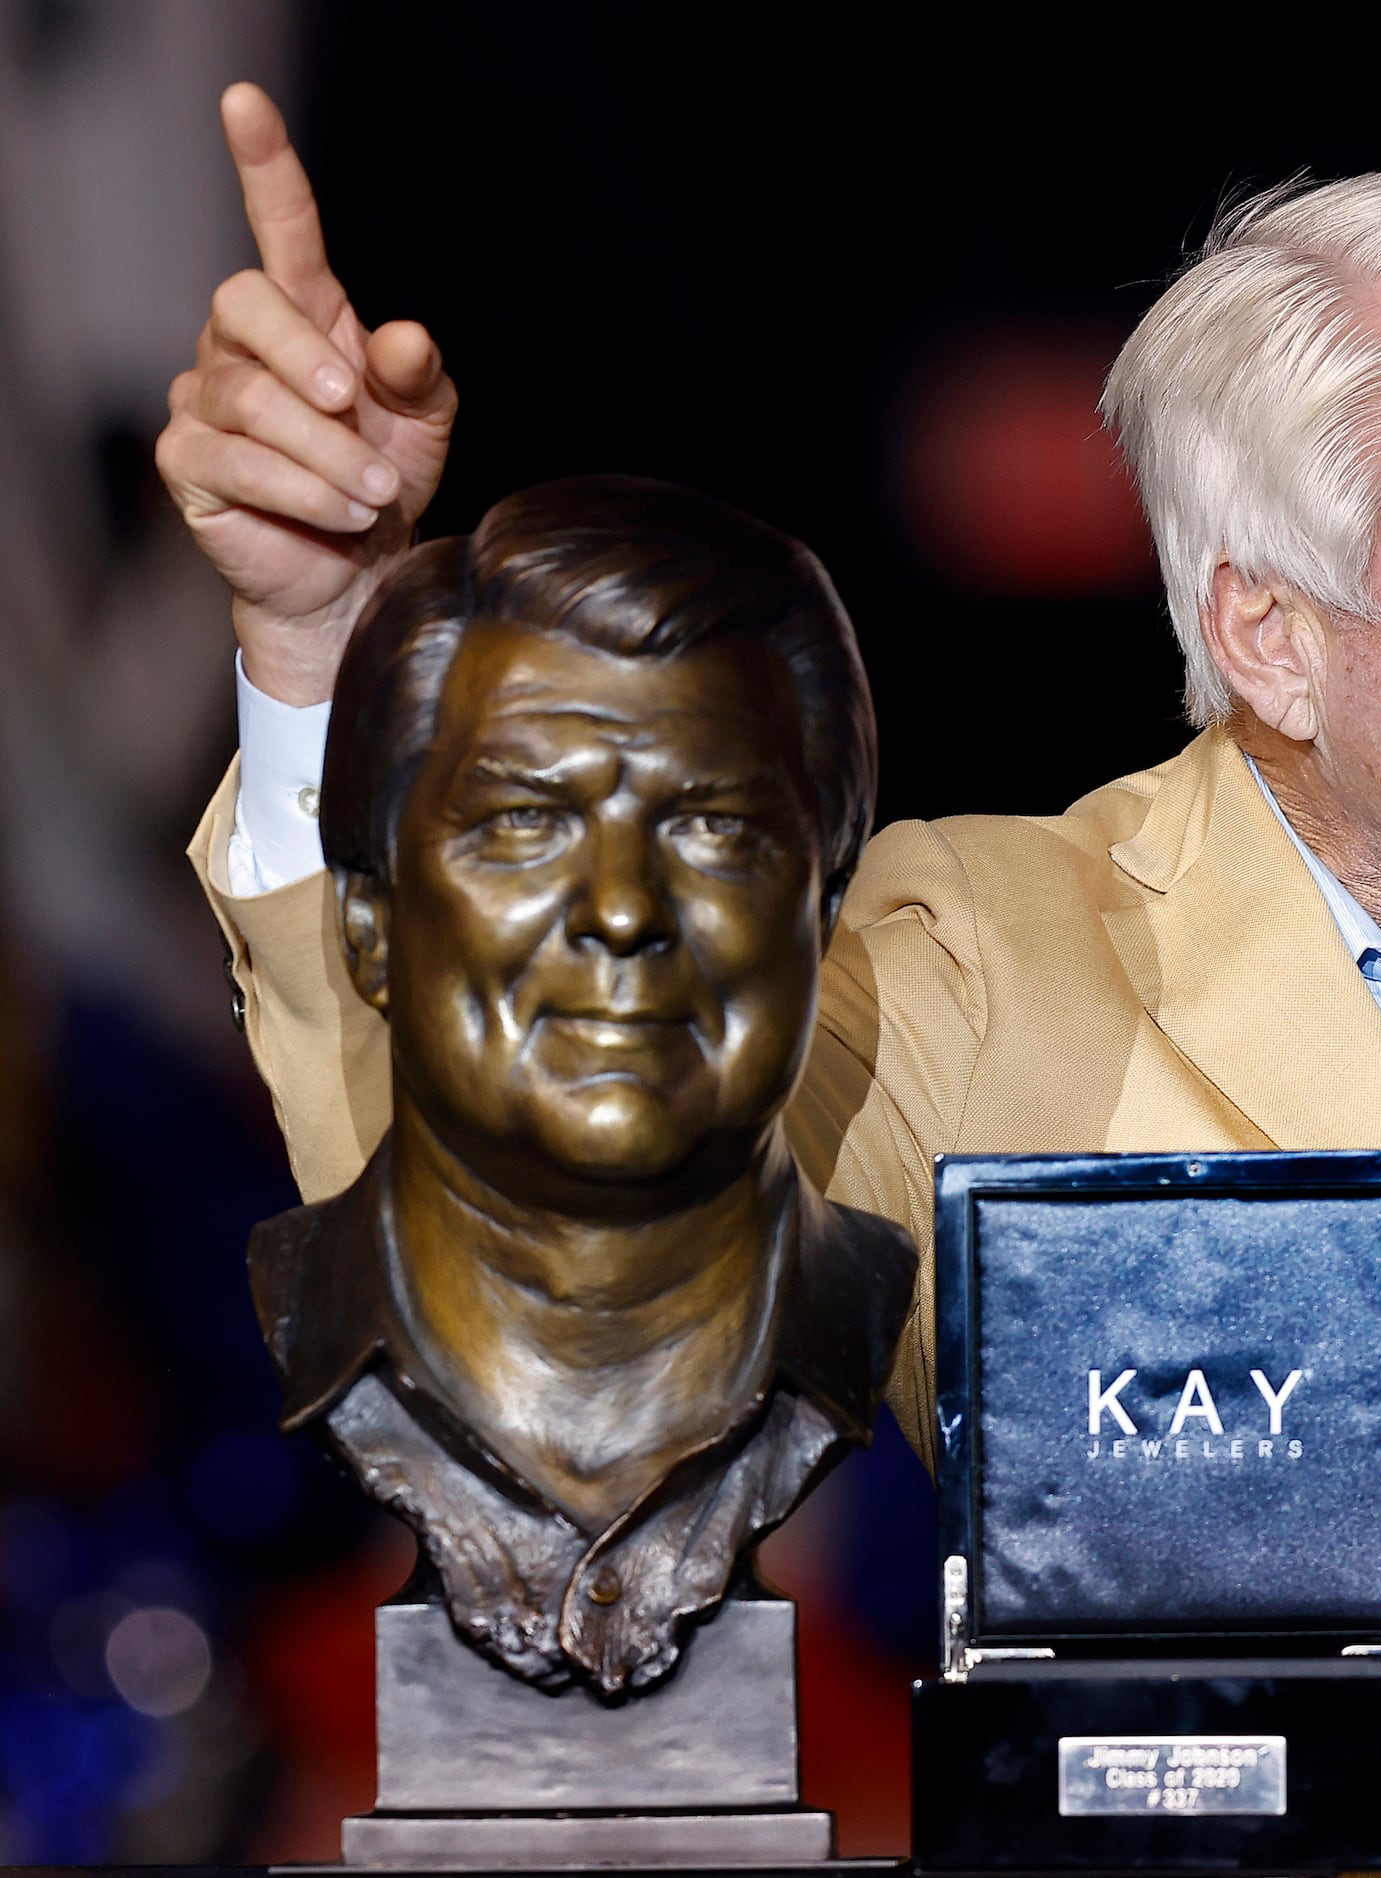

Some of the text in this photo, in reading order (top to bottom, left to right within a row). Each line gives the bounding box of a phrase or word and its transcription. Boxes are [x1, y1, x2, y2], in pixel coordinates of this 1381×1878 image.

[1087, 1368, 1303, 1436] KAY
[1087, 1439, 1304, 1459] JEWELERS
[1088, 1744, 1258, 1770] Jimmy Johnson
[1105, 1767, 1158, 1788] Class
[1164, 1767, 1186, 1788] of
